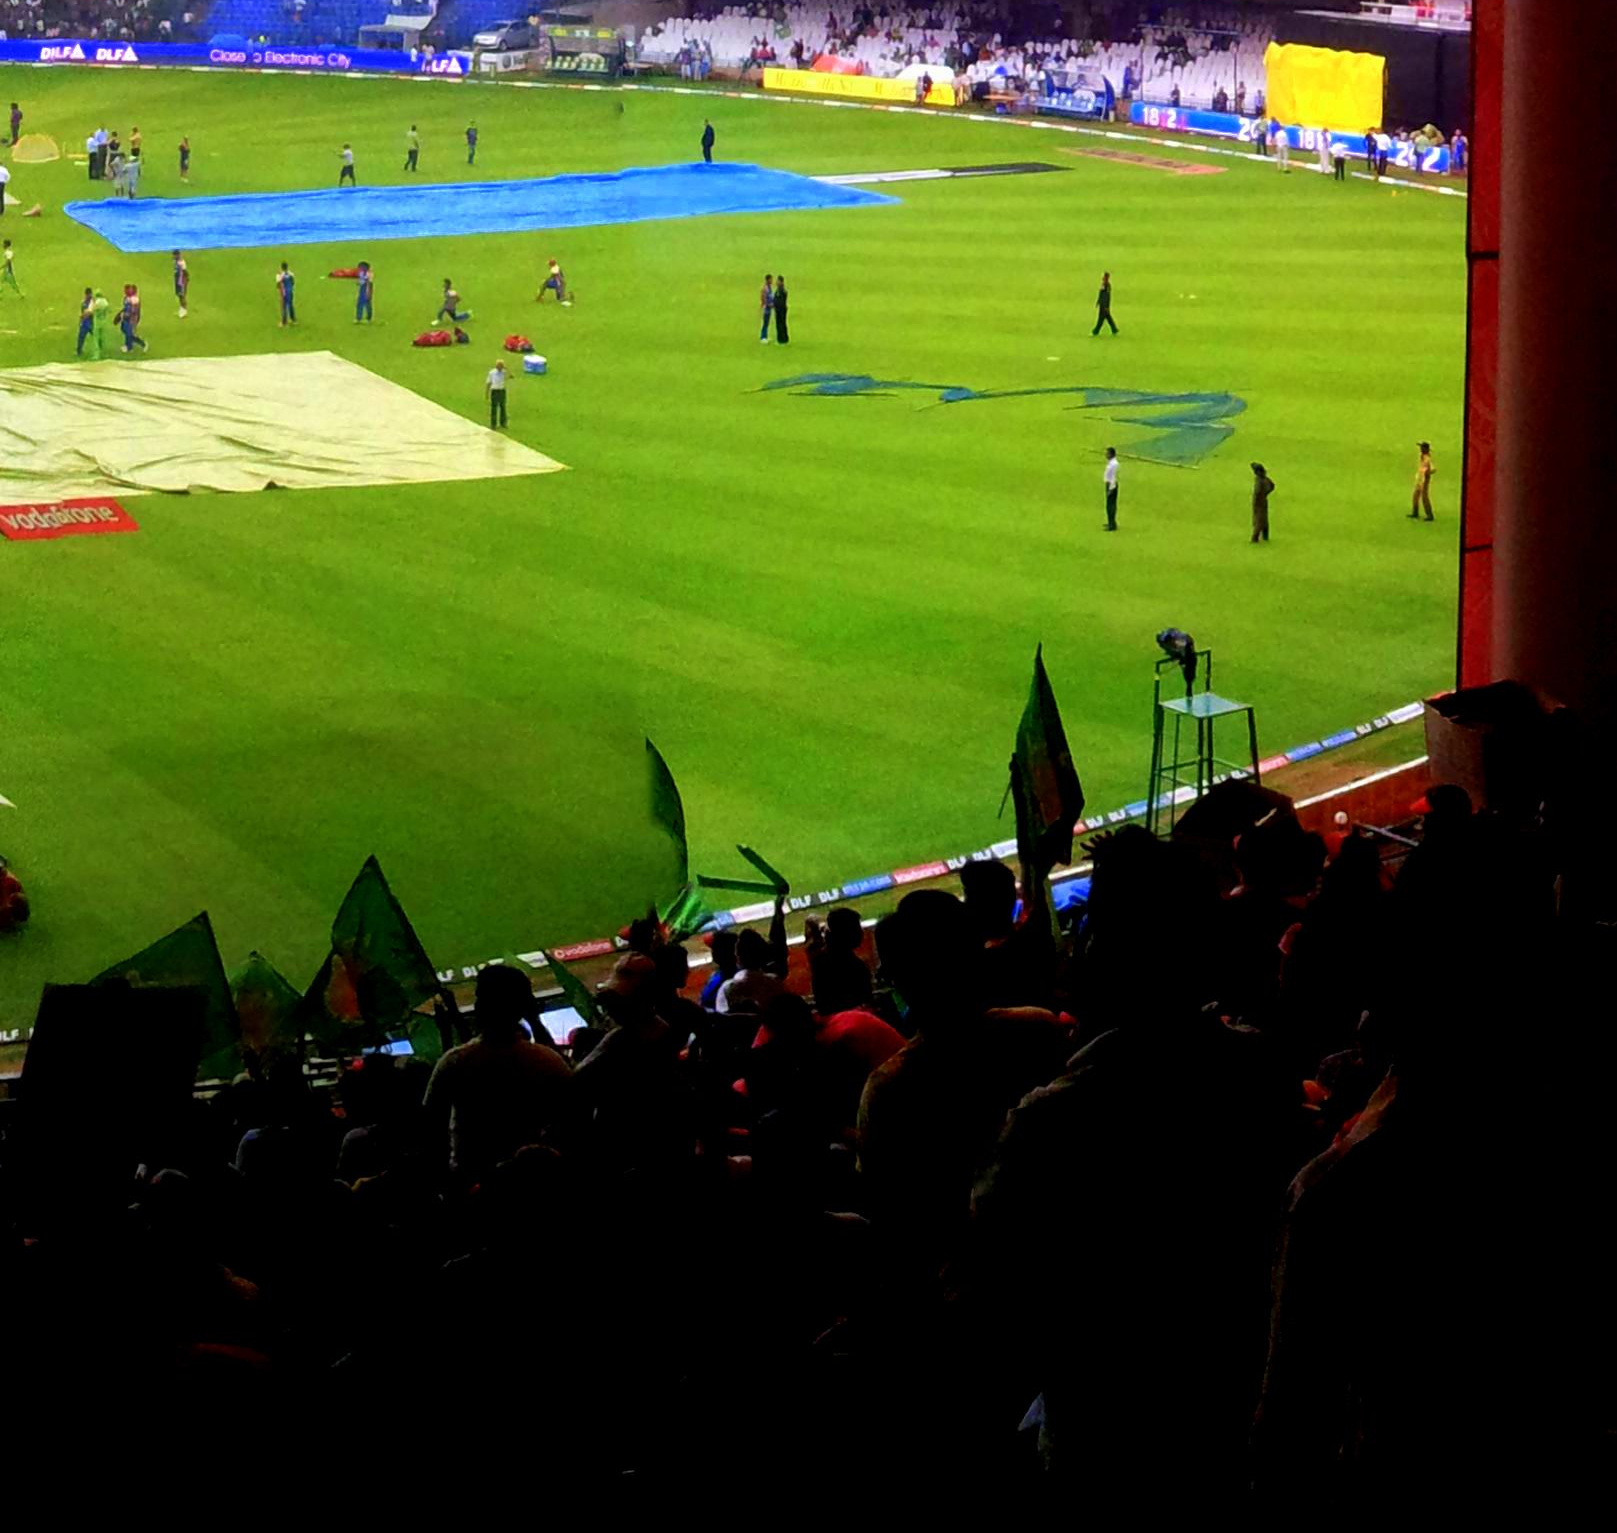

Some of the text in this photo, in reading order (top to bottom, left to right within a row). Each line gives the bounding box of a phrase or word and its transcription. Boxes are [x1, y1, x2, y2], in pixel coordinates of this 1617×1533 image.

[96, 47, 127, 62] DLF
[210, 49, 246, 62] Close
[264, 52, 322, 66] Electronic
[325, 53, 352, 69] City
[790, 888, 839, 909] DLF DLF
[567, 941, 610, 958] vodafone
